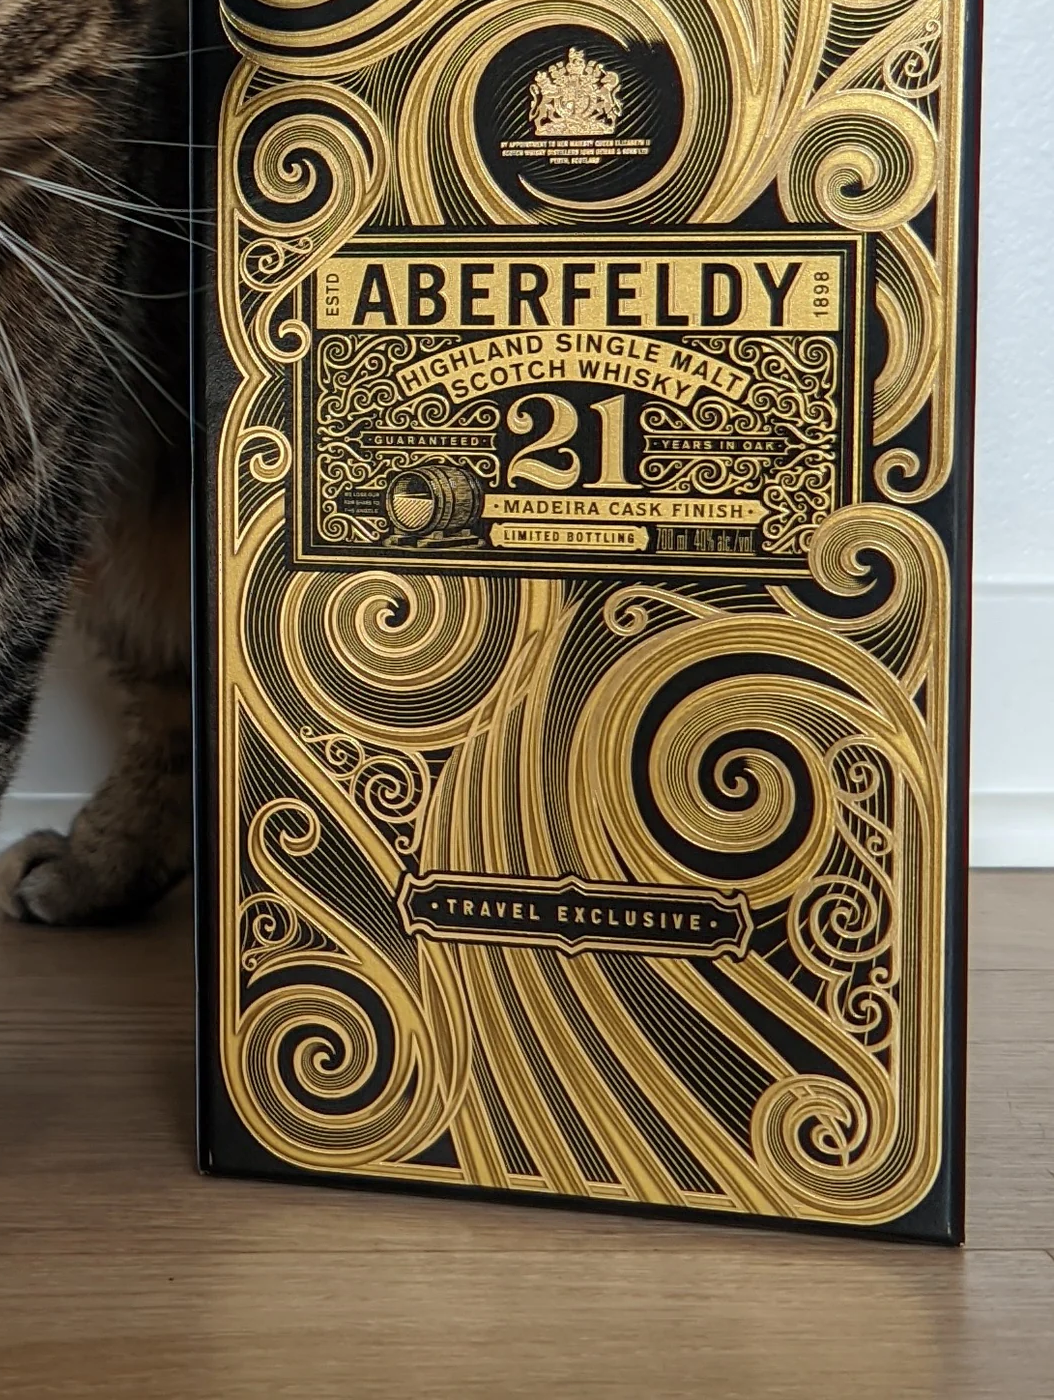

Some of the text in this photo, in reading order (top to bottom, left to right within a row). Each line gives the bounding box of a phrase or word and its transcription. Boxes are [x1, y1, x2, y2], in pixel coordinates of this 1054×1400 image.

[325, 271, 340, 318] ESTD
[351, 262, 804, 328] ABERFELDY
[813, 270, 830, 319] 1898
[401, 333, 745, 394] HIGHLAND SINGLE MALT
[452, 360, 692, 402] SCOTCH WHISKY
[373, 434, 480, 448] GUARANTEED
[506, 393, 643, 490] 21
[662, 439, 776, 452] YEARS IN OAK
[504, 500, 743, 518] MADEIRA CASK FINISH
[504, 529, 635, 544] LIMITED BOTTLING
[656, 528, 674, 550] 700
[694, 529, 714, 551] 40%
[447, 899, 701, 931] TRAVEL EXCLUSIVE
